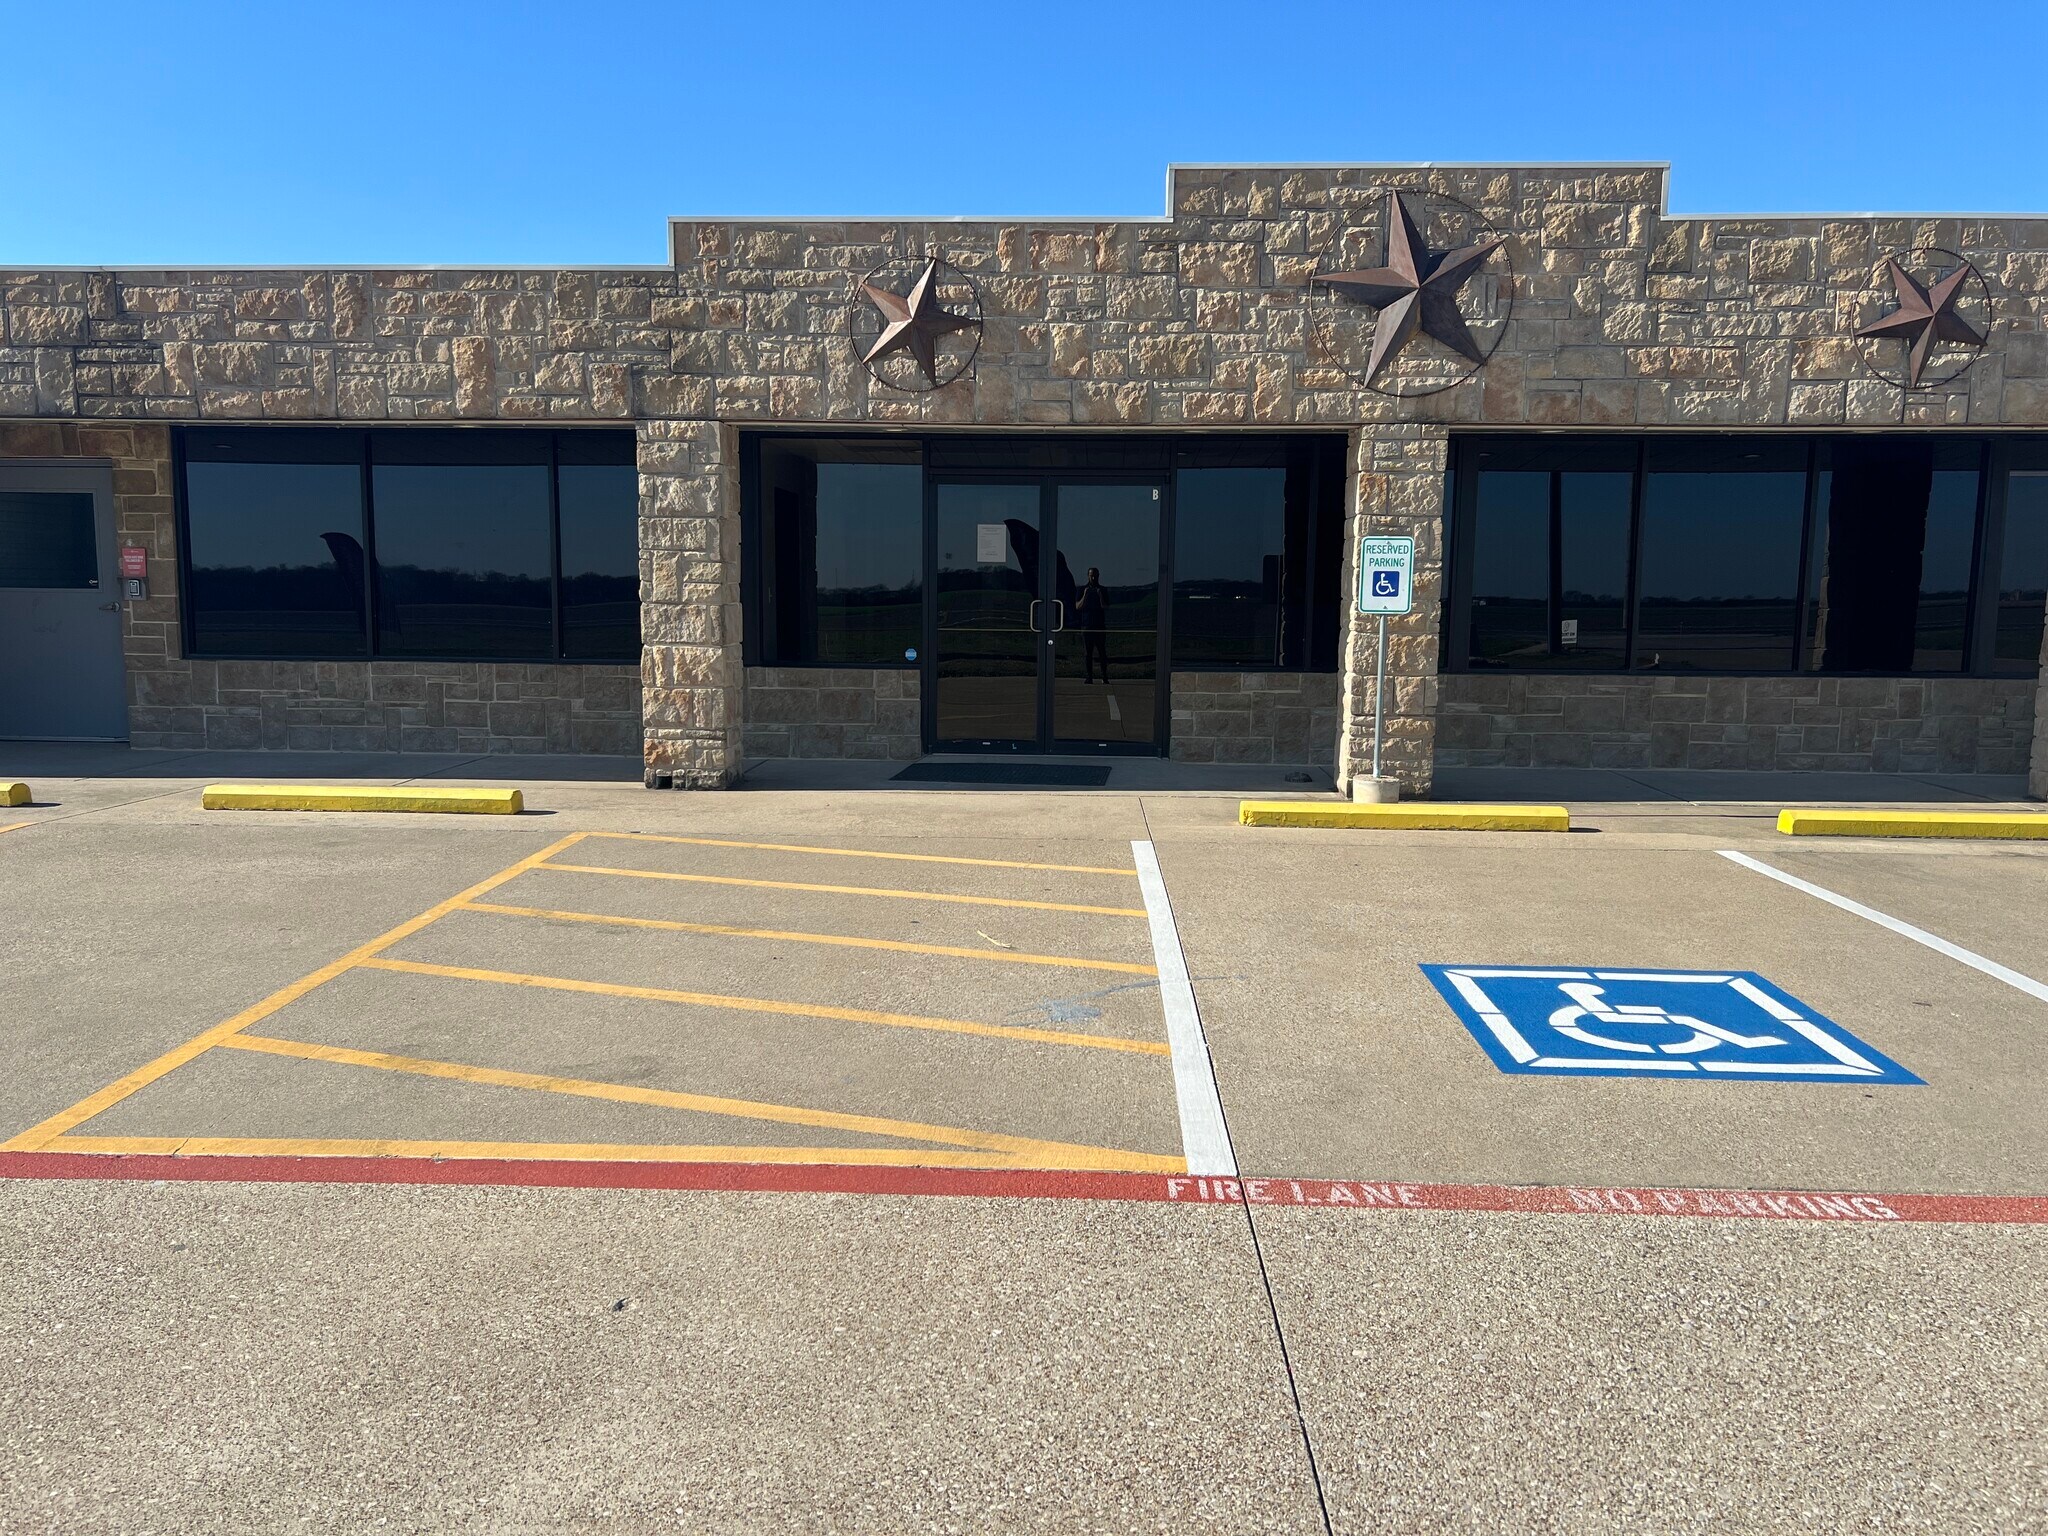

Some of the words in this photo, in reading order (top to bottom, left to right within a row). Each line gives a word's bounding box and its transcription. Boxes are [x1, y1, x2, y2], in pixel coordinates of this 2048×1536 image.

[1152, 488, 1159, 501] B
[1366, 544, 1409, 555] RESERVED
[1369, 558, 1405, 568] PARKING
[1167, 1178, 1274, 1200] FIRE
[1290, 1181, 1427, 1206] LANE
